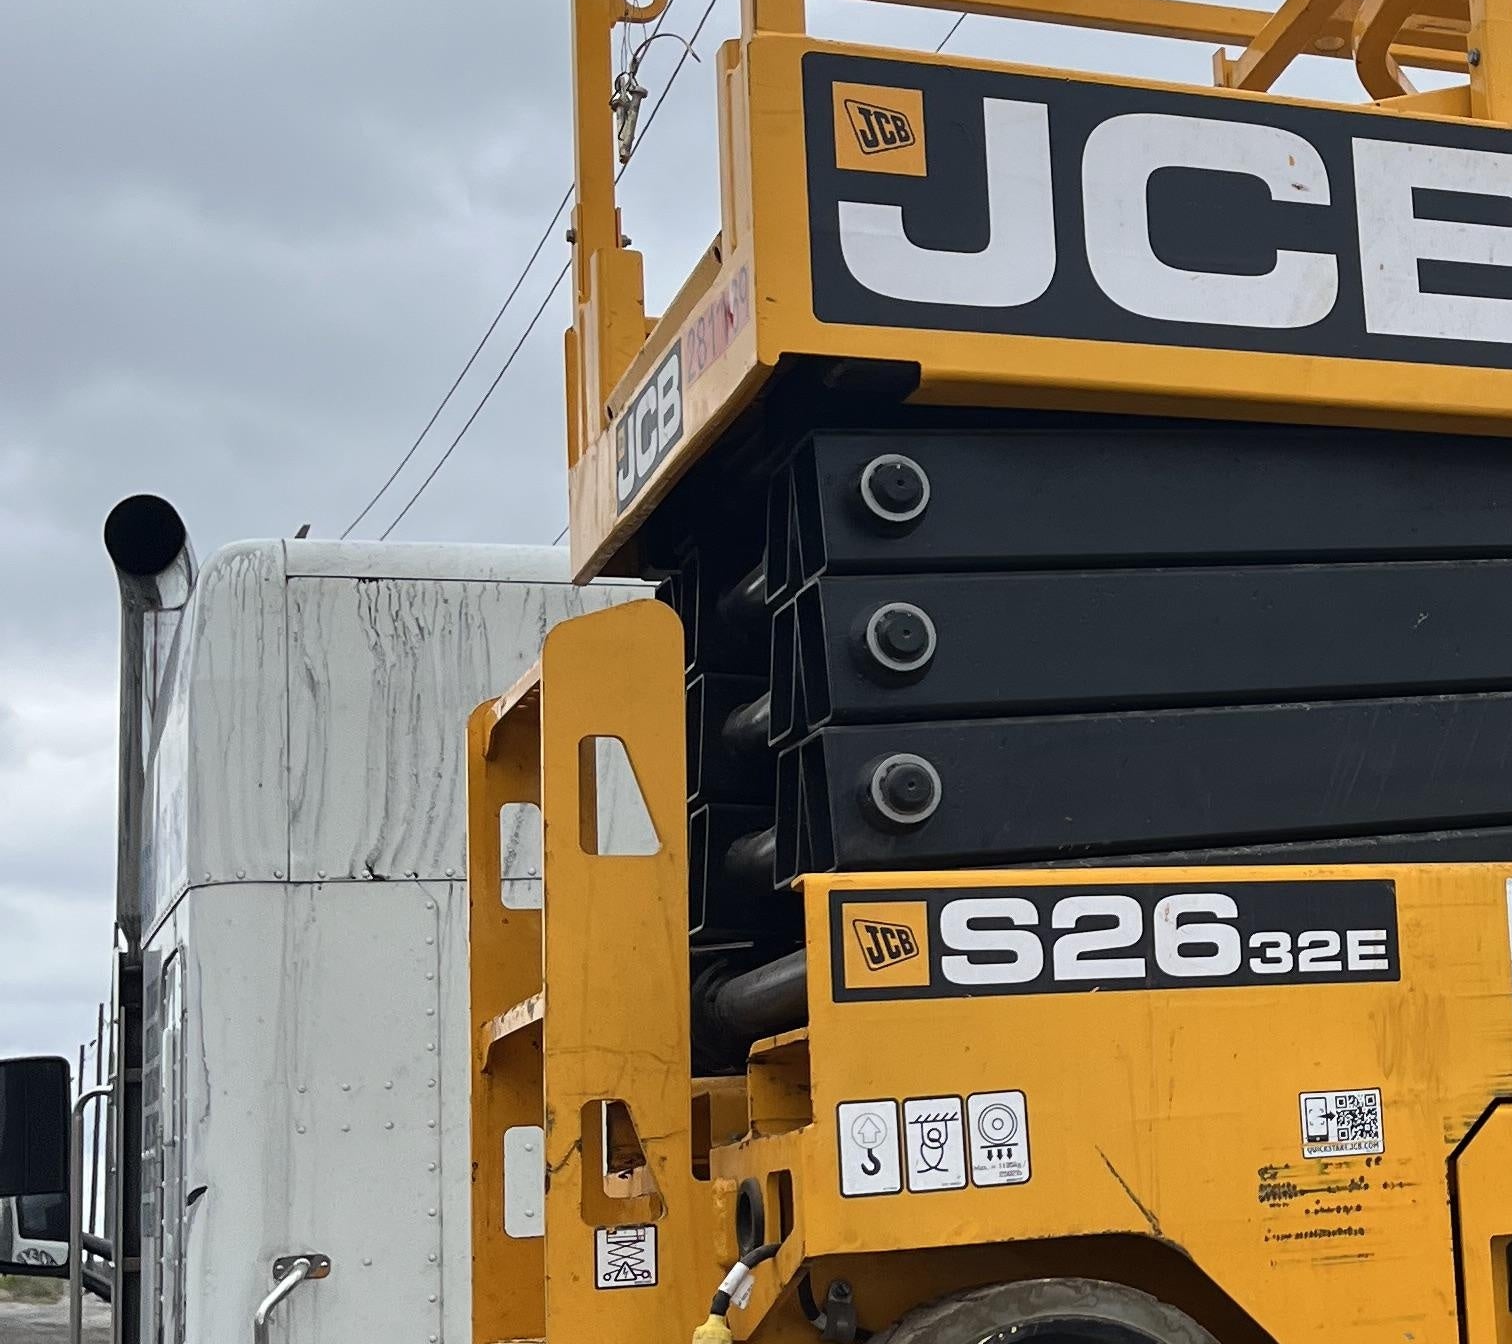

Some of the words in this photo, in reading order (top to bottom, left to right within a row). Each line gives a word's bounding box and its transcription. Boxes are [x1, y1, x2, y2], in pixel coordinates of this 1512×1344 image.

[858, 103, 911, 149] JCB
[617, 353, 682, 503] JCB
[865, 924, 915, 966] JCB
